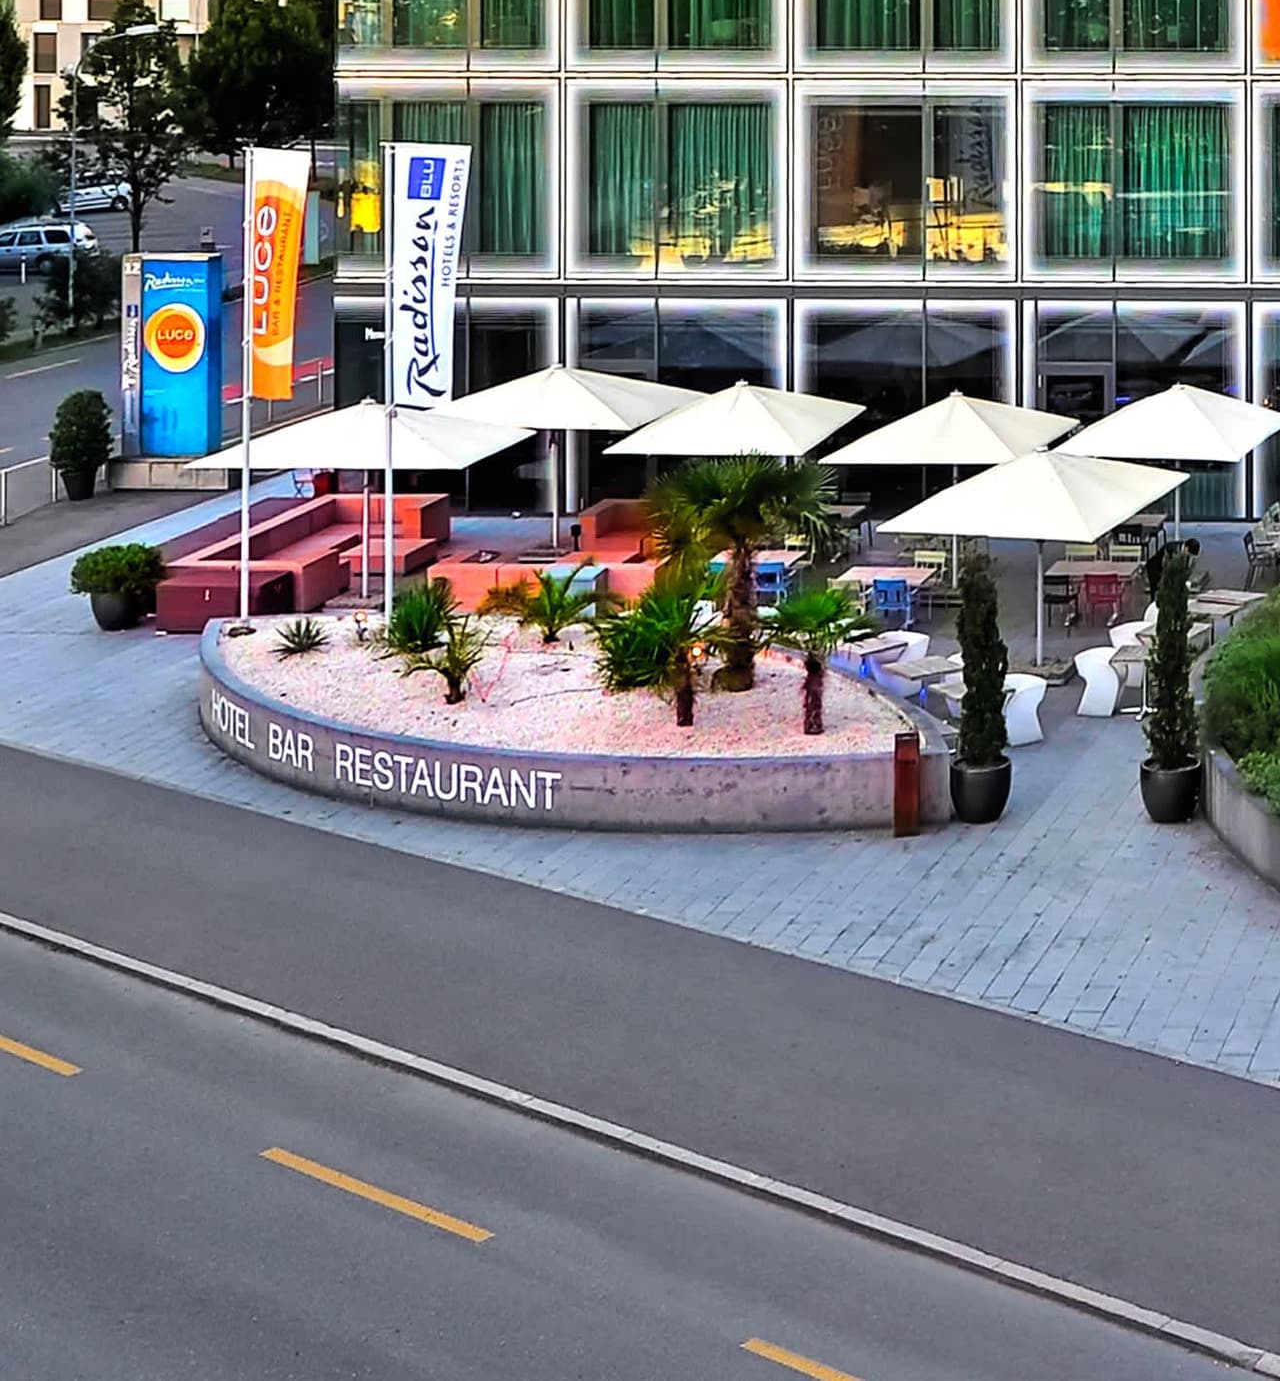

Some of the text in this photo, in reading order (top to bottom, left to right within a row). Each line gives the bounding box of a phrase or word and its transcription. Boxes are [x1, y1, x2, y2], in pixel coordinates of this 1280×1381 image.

[123, 262, 141, 276] 12
[275, 210, 293, 294] RESTAURANT
[441, 158, 465, 287] HOTELS & RESORTS
[271, 311, 280, 337] BAR
[399, 159, 447, 397] Radisson BLU
[211, 688, 562, 811] HOTEL BAR RESTAURANT
